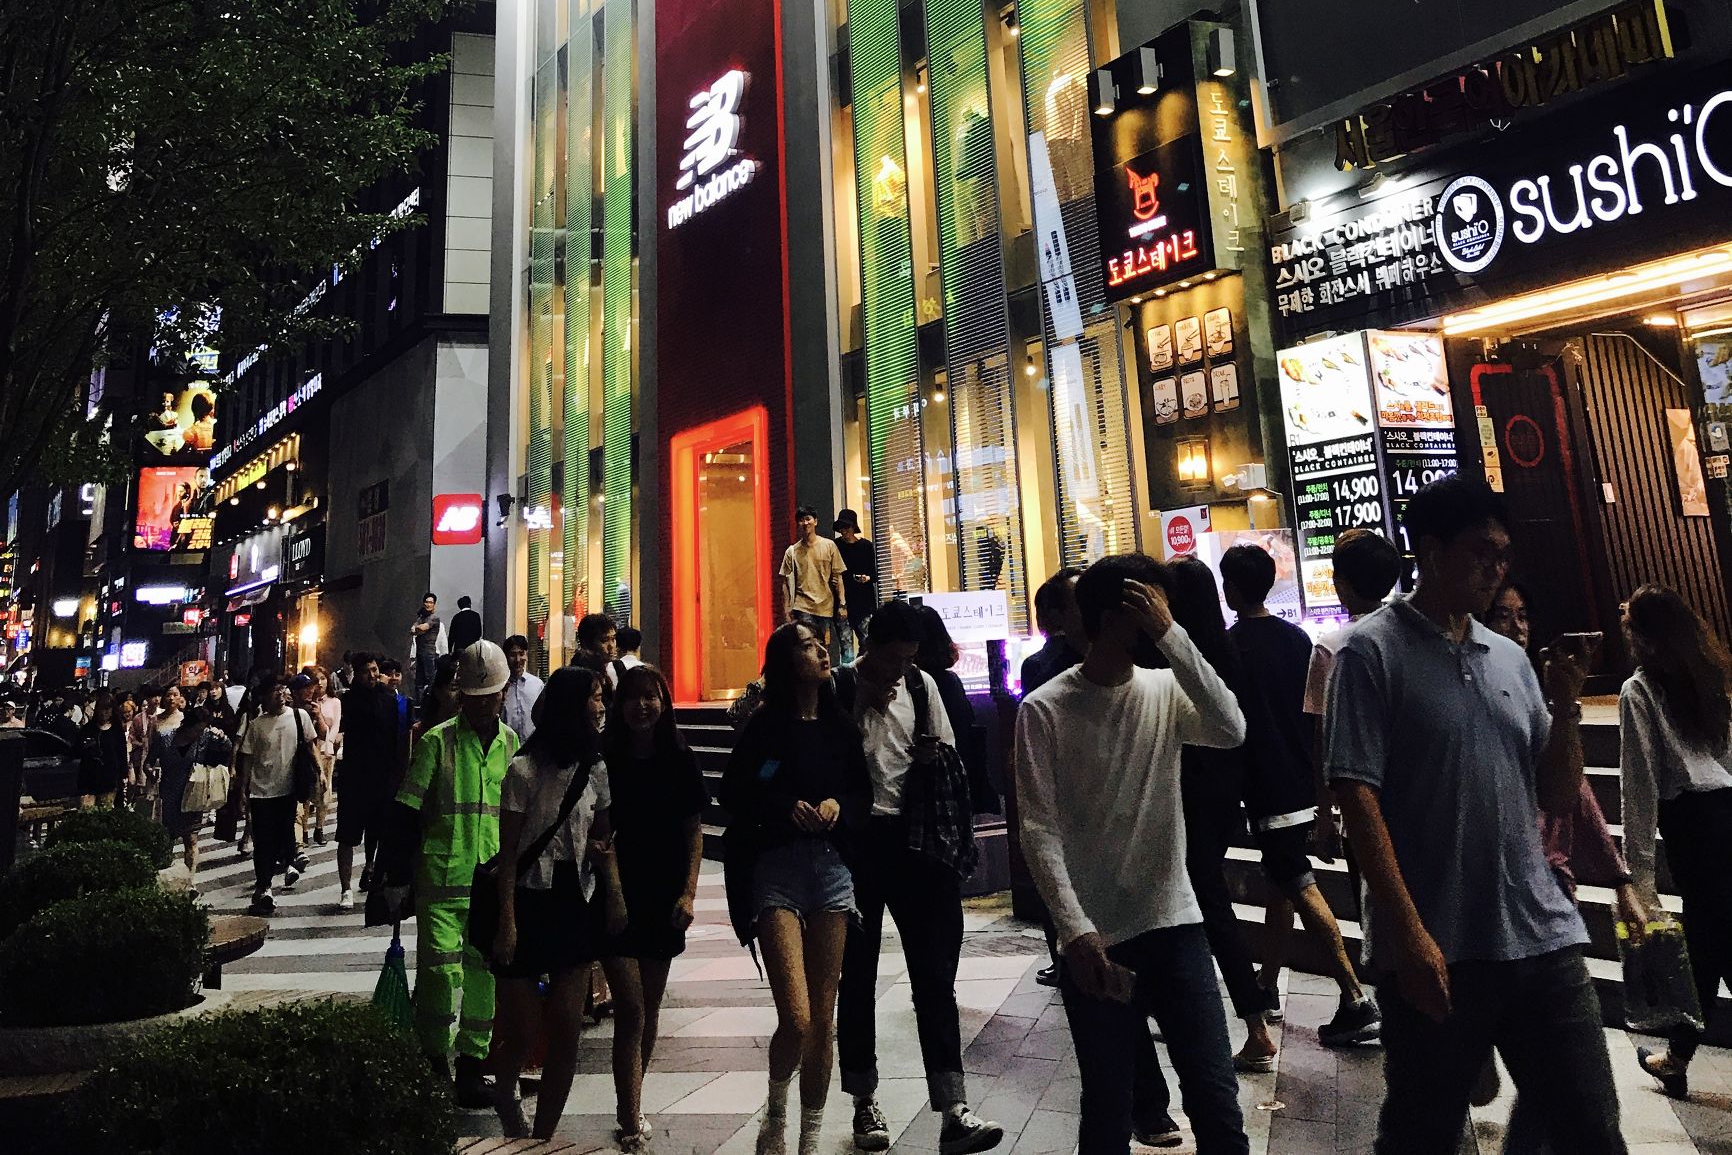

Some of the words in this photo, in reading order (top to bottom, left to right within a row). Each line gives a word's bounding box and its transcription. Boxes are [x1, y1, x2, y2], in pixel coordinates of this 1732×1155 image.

[1209, 92, 1245, 252] 도쿄스테이크
[667, 192, 695, 230] new
[694, 158, 757, 214] balance
[1108, 230, 1199, 287] 도쿄스테이크
[1271, 232, 1326, 265] BLACK
[1276, 254, 1327, 290] 스시오
[1329, 220, 1439, 275] 블랙컨테이너
[1278, 287, 1315, 318] 무제한
[1319, 270, 1372, 306] 회전스시
[1294, 463, 1322, 474] BLACK
[1325, 454, 1375, 469] CONTAINER
[1333, 475, 1379, 502] 14,900
[1335, 501, 1382, 528] 17,900
[291, 537, 311, 562] LLOYD
[941, 603, 1006, 621] 도쿄스테이크
[1287, 608, 1298, 618] B1
